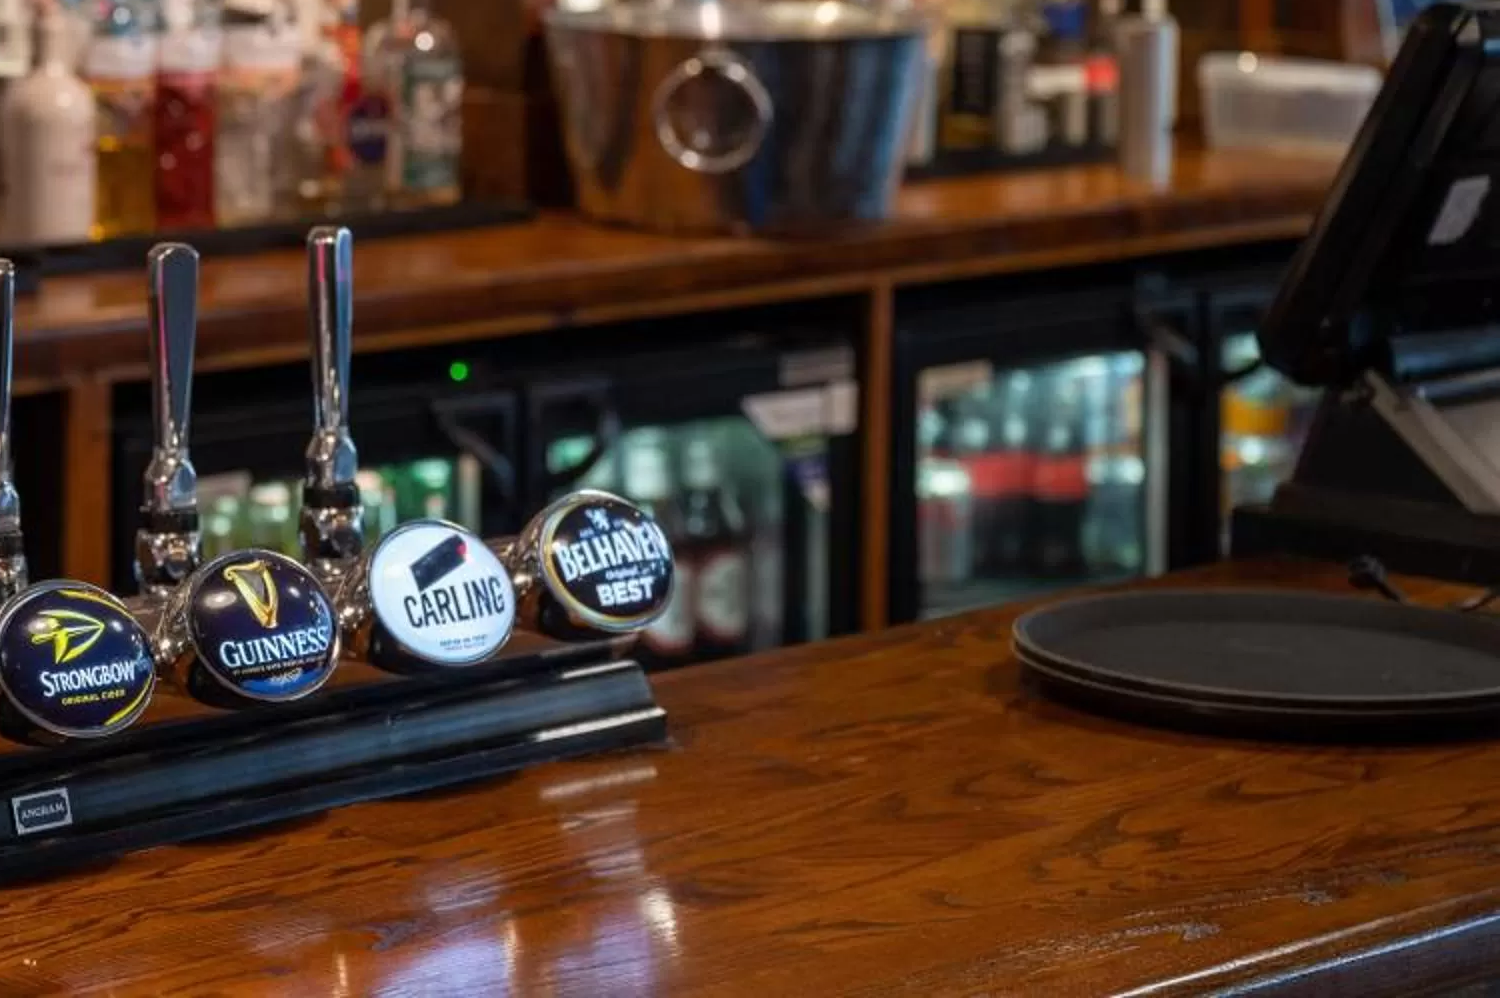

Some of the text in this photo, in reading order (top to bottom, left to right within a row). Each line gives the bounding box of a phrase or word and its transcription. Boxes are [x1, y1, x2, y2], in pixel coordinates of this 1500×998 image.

[553, 521, 669, 582] BELHAVEN
[403, 575, 506, 629] CARLING
[596, 576, 655, 606] BEST
[219, 625, 330, 668] GUINNESS
[40, 660, 135, 697] STRONGBOW
